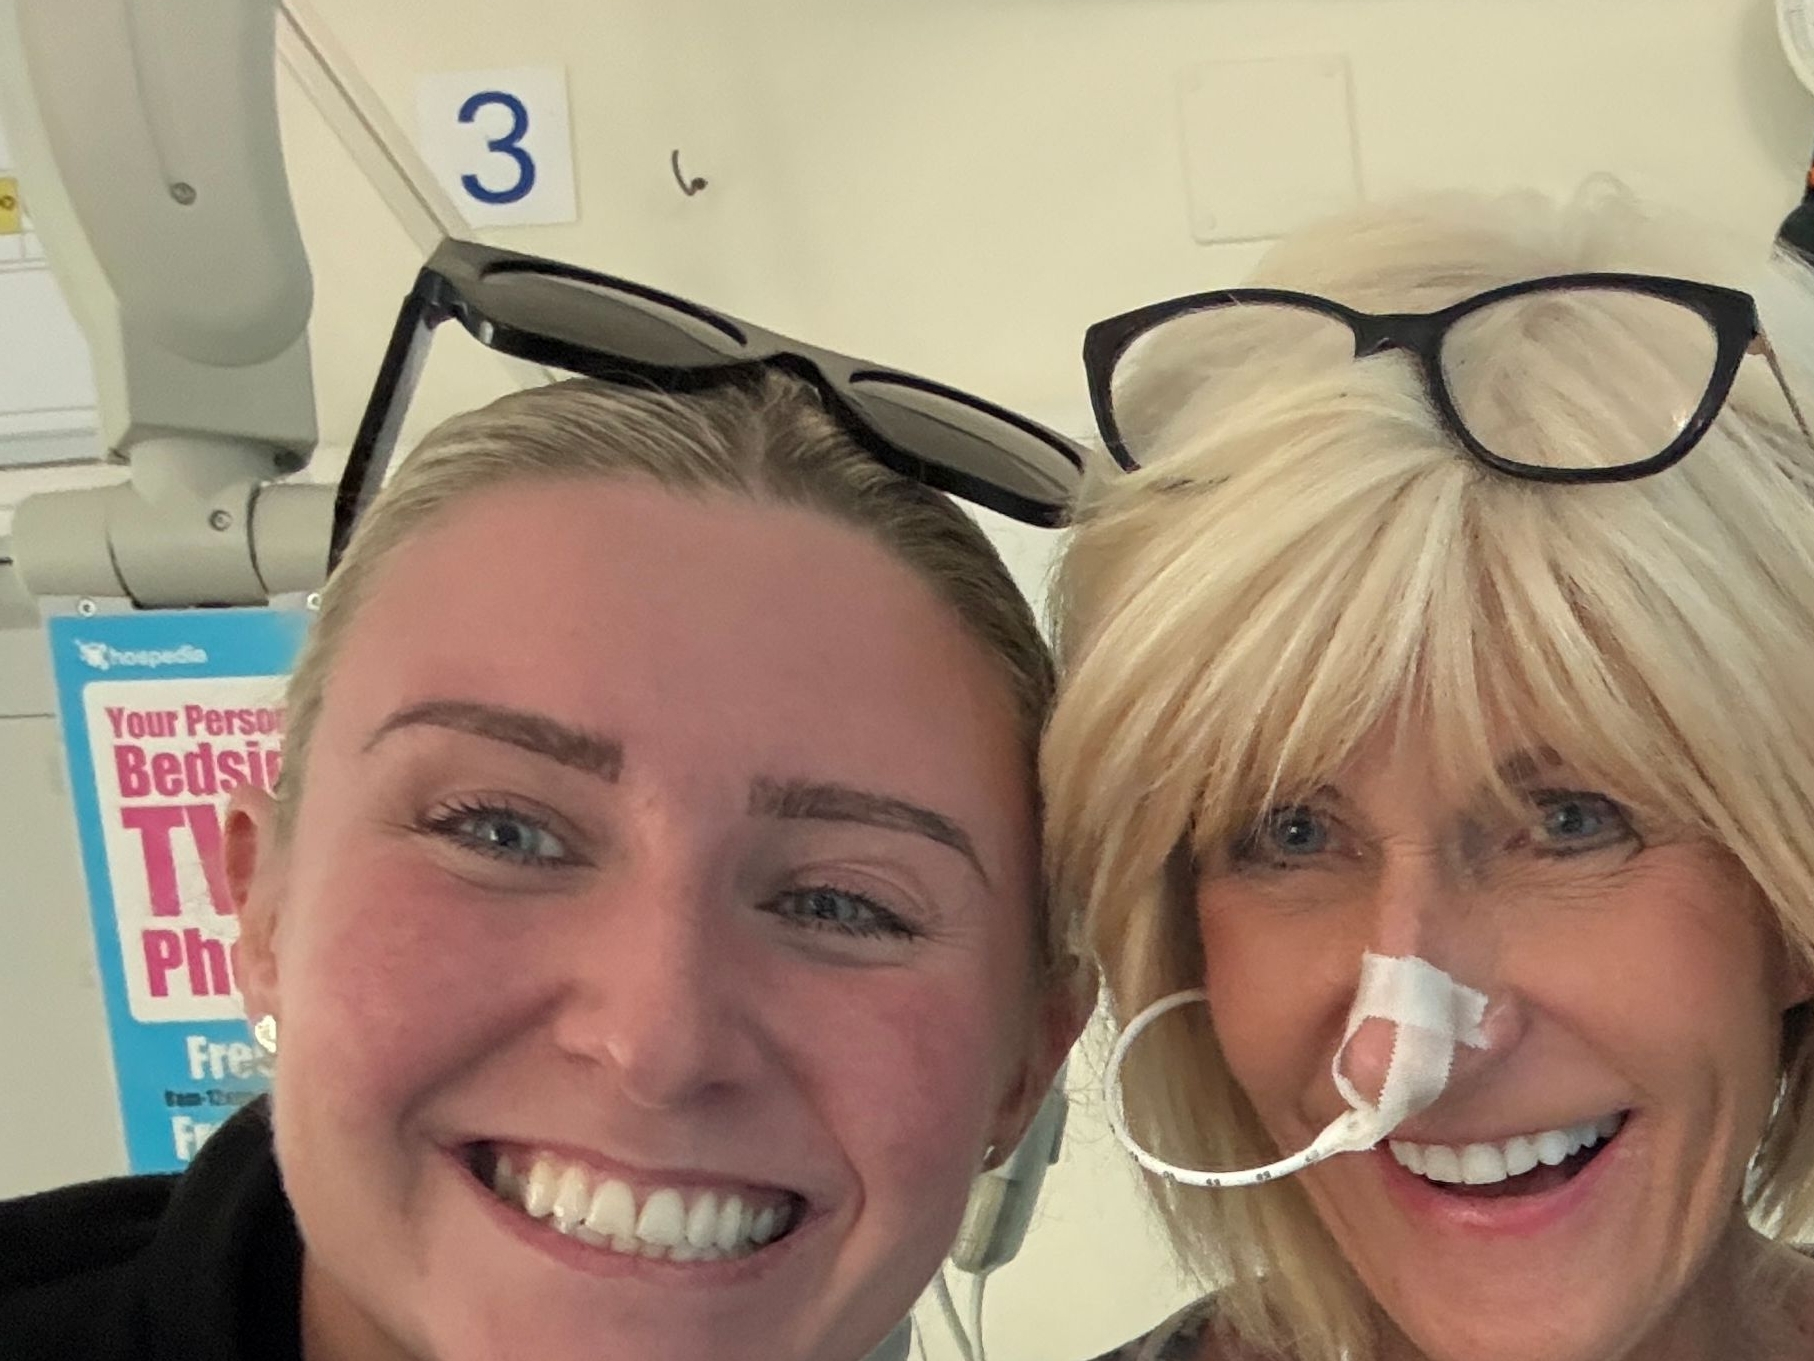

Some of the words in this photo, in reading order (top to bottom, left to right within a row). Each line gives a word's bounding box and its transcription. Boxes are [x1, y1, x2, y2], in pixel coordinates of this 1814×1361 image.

[457, 90, 536, 204] 3
[105, 706, 178, 738] Your
[142, 927, 232, 997] Ph
[171, 1115, 222, 1160] Fr
